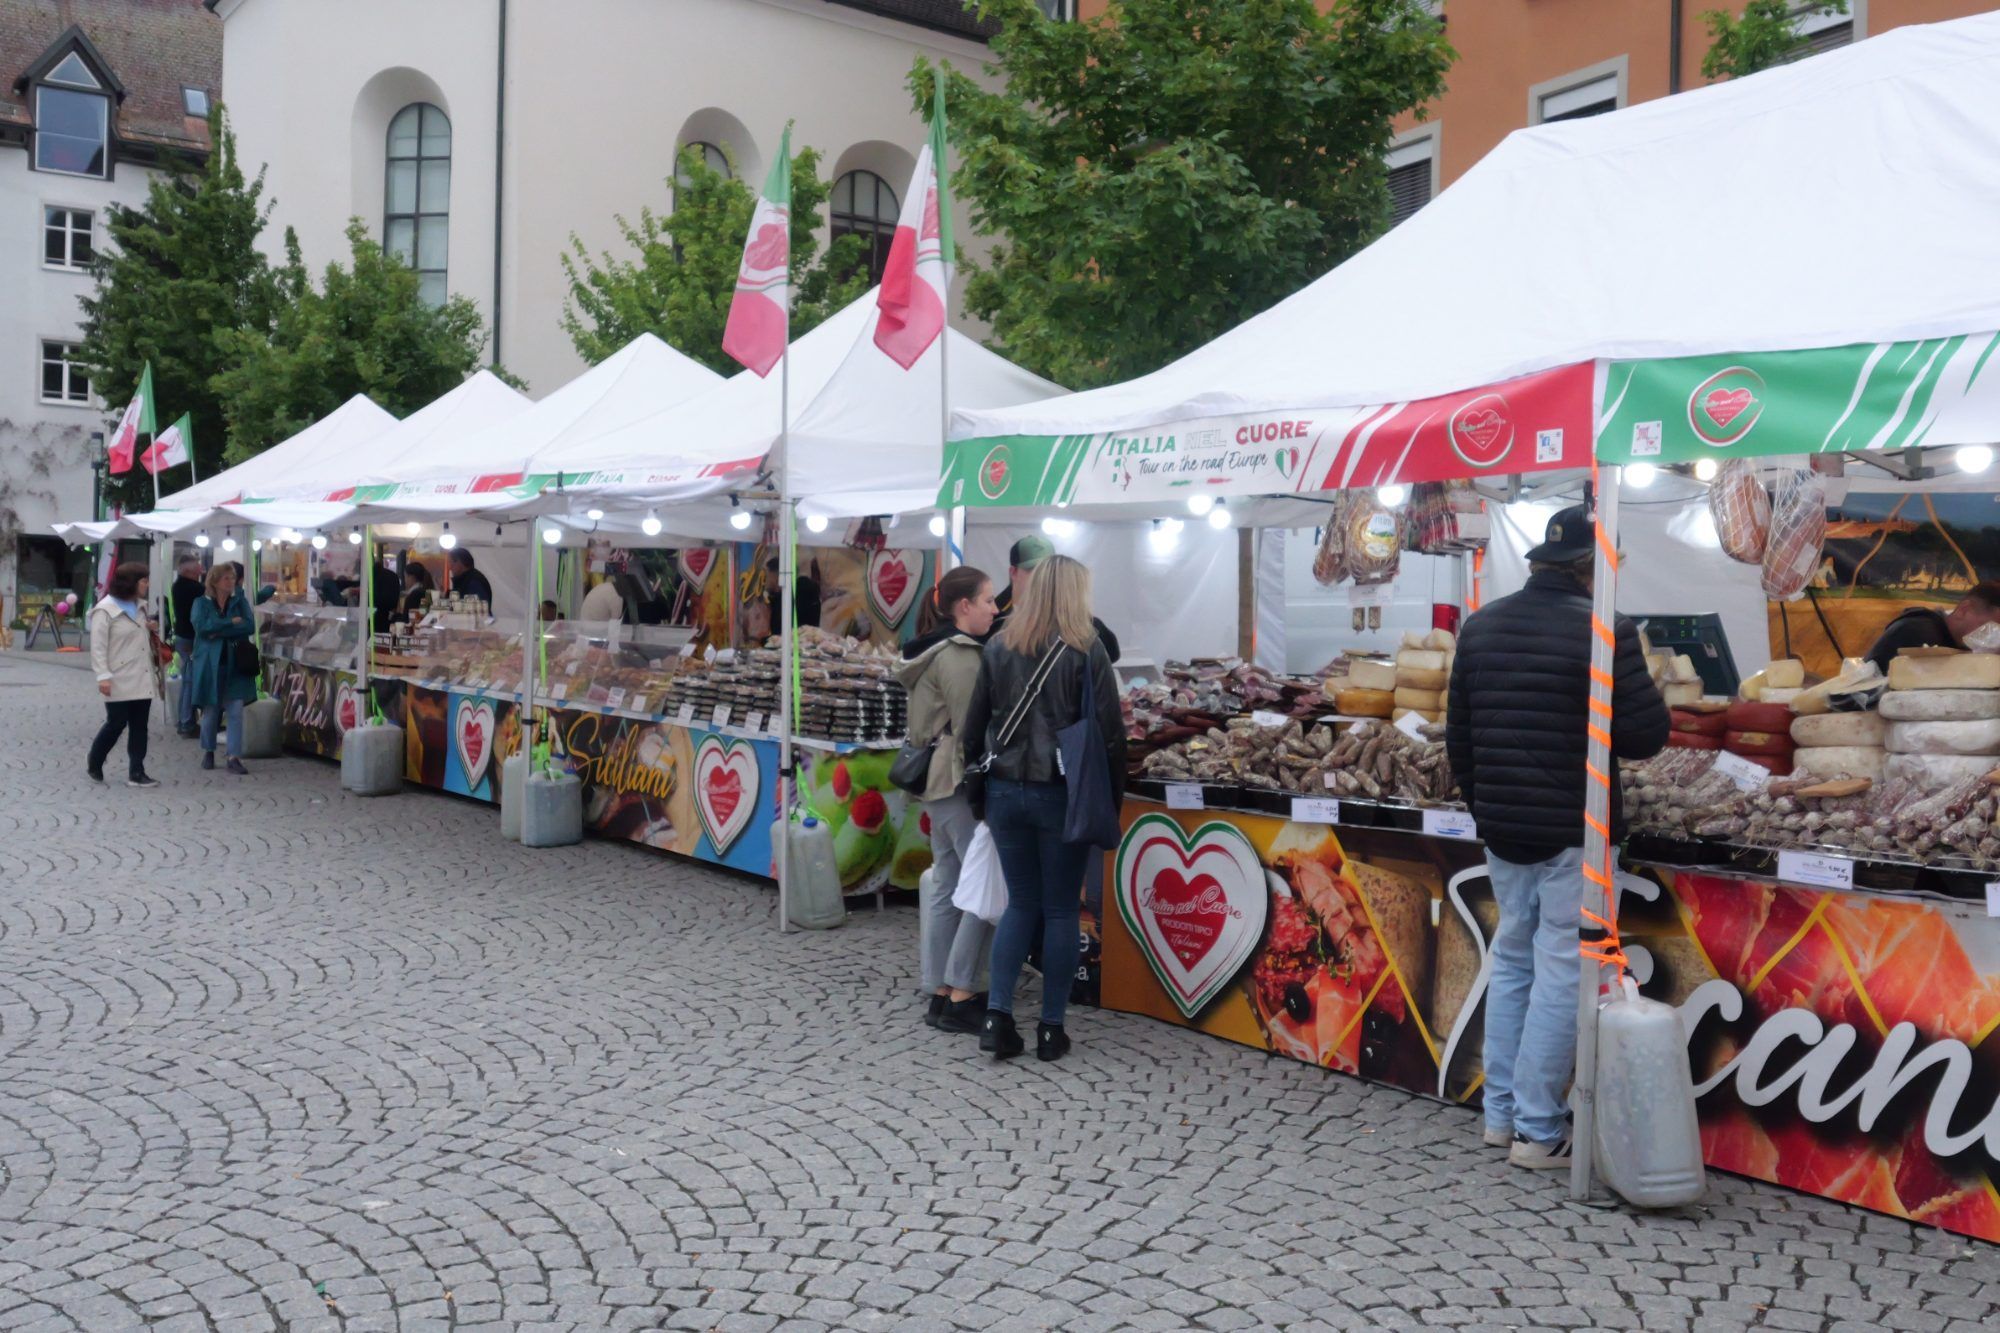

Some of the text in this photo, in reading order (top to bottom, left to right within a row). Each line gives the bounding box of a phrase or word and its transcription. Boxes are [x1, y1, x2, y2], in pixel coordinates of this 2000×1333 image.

[1108, 420, 1313, 457] ITALIA NEL CUORE
[1139, 451, 1268, 474] Tour on the road Europe
[566, 712, 676, 799] Siciliani
[1140, 885, 1243, 919] Italia nel Cuore
